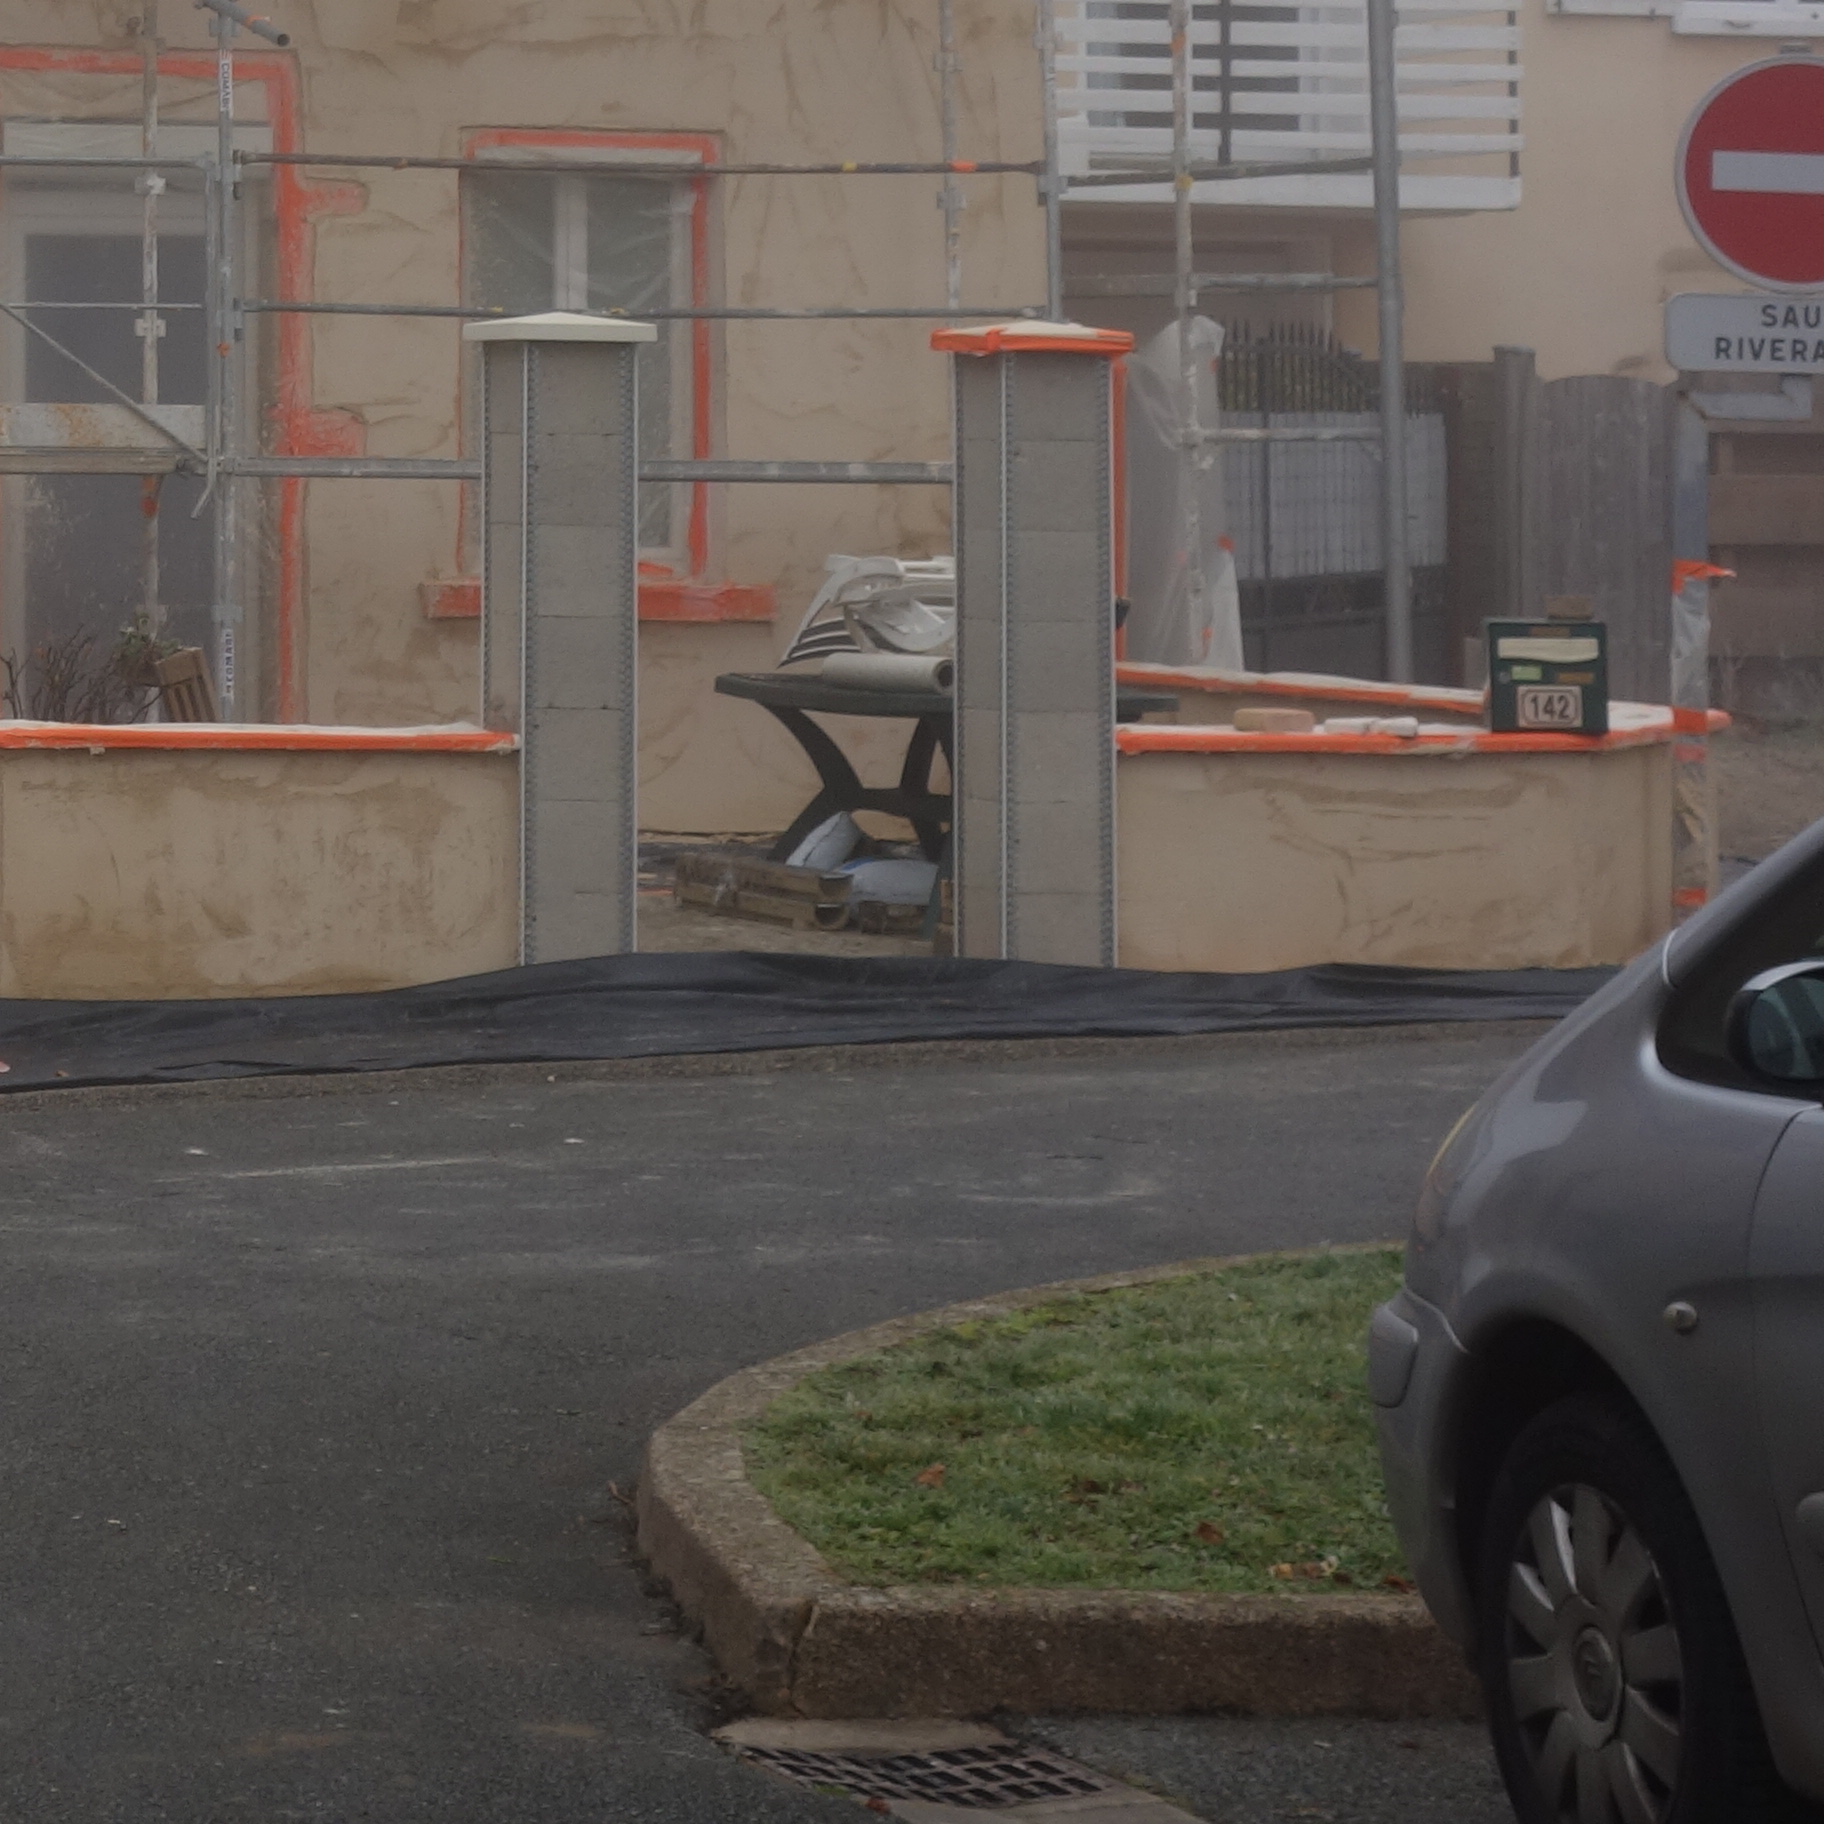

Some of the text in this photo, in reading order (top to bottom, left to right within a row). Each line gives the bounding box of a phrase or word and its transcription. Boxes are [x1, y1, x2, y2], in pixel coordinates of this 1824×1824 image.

[1761, 303, 1821, 329] SAU
[1714, 336, 1824, 363] RIVERA
[1529, 694, 1570, 719] 142
